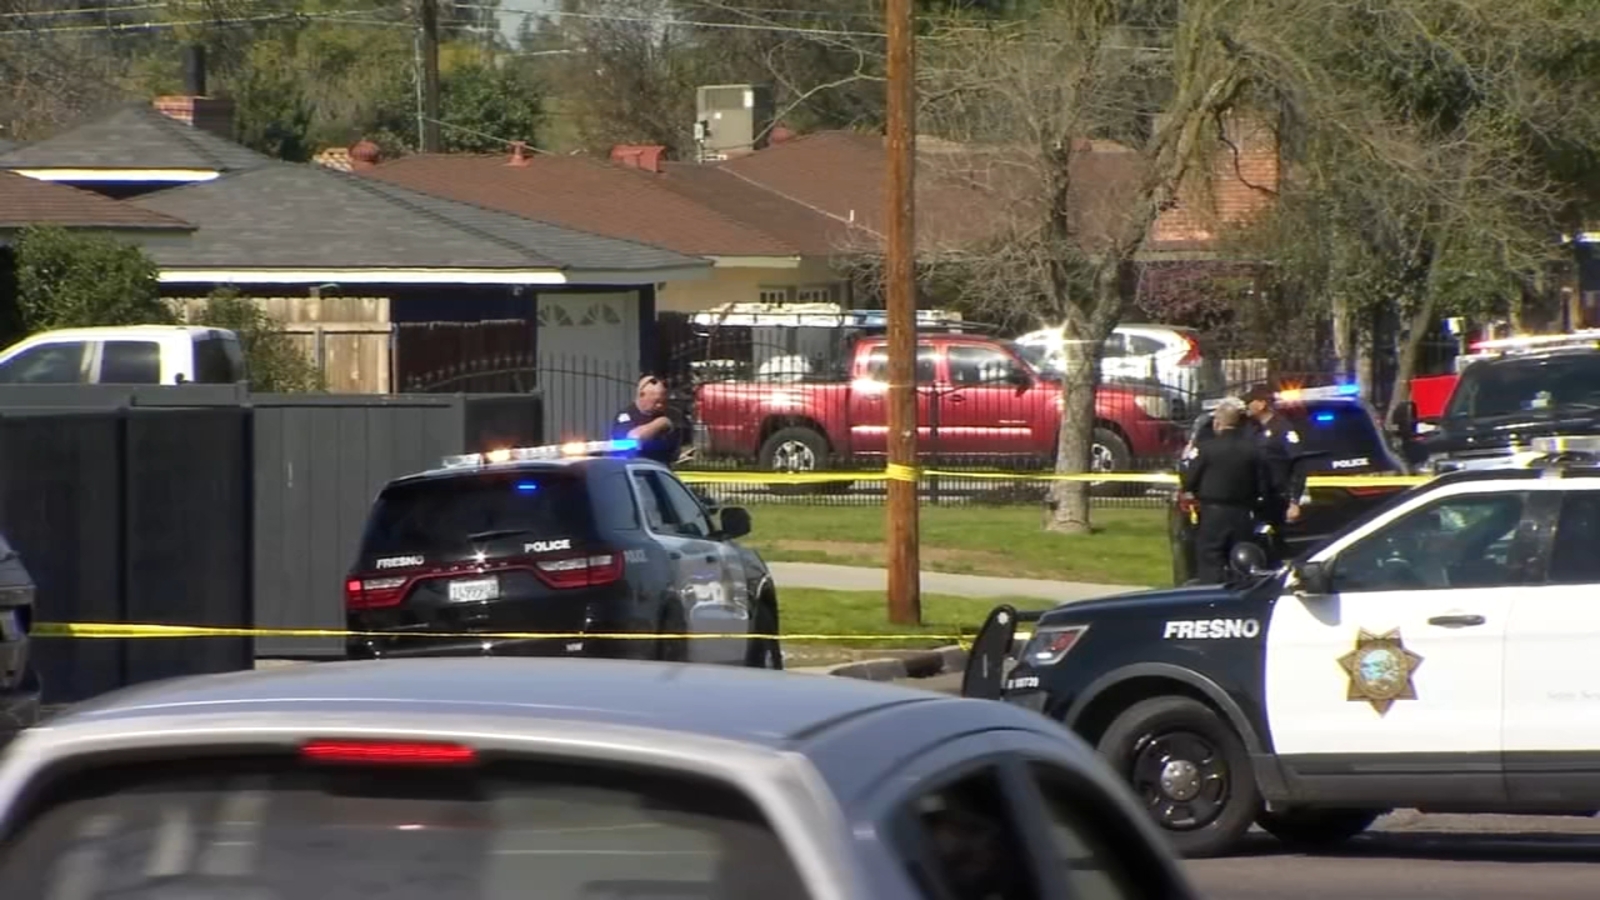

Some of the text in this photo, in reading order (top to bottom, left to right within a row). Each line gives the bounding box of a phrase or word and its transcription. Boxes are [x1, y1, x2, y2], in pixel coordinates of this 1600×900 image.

[1332, 457, 1369, 469] POLICE
[525, 540, 571, 553] POLICE
[376, 555, 424, 570] FRESNO
[1163, 618, 1260, 639] FRESNO
